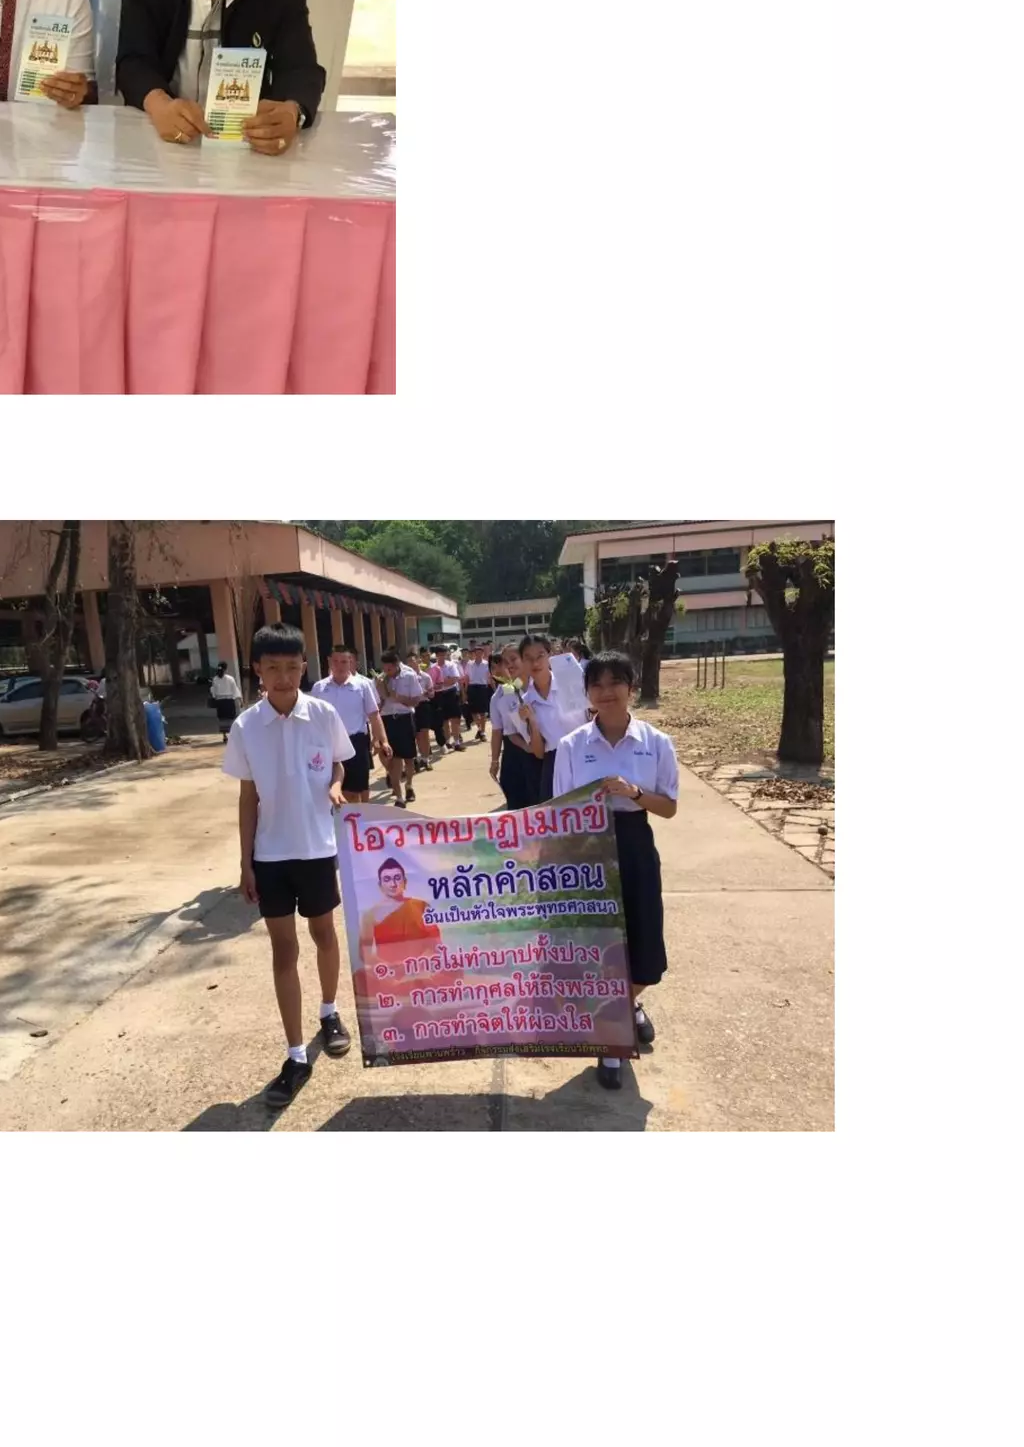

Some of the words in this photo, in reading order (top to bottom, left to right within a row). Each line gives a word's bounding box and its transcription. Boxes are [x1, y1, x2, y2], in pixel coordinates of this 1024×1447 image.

[428, 860, 604, 900] หลักคำสอน
[424, 899, 617, 925] อันเป็นหัวใจพระพุทธศาสนา
[404, 934, 601, 974] การไม่ทำบาปทั้งปวง
[412, 972, 626, 1007] การทำกุศลให้ถึงพร้อม
[414, 1005, 593, 1039] การทำจิตให้ผ่องใส
